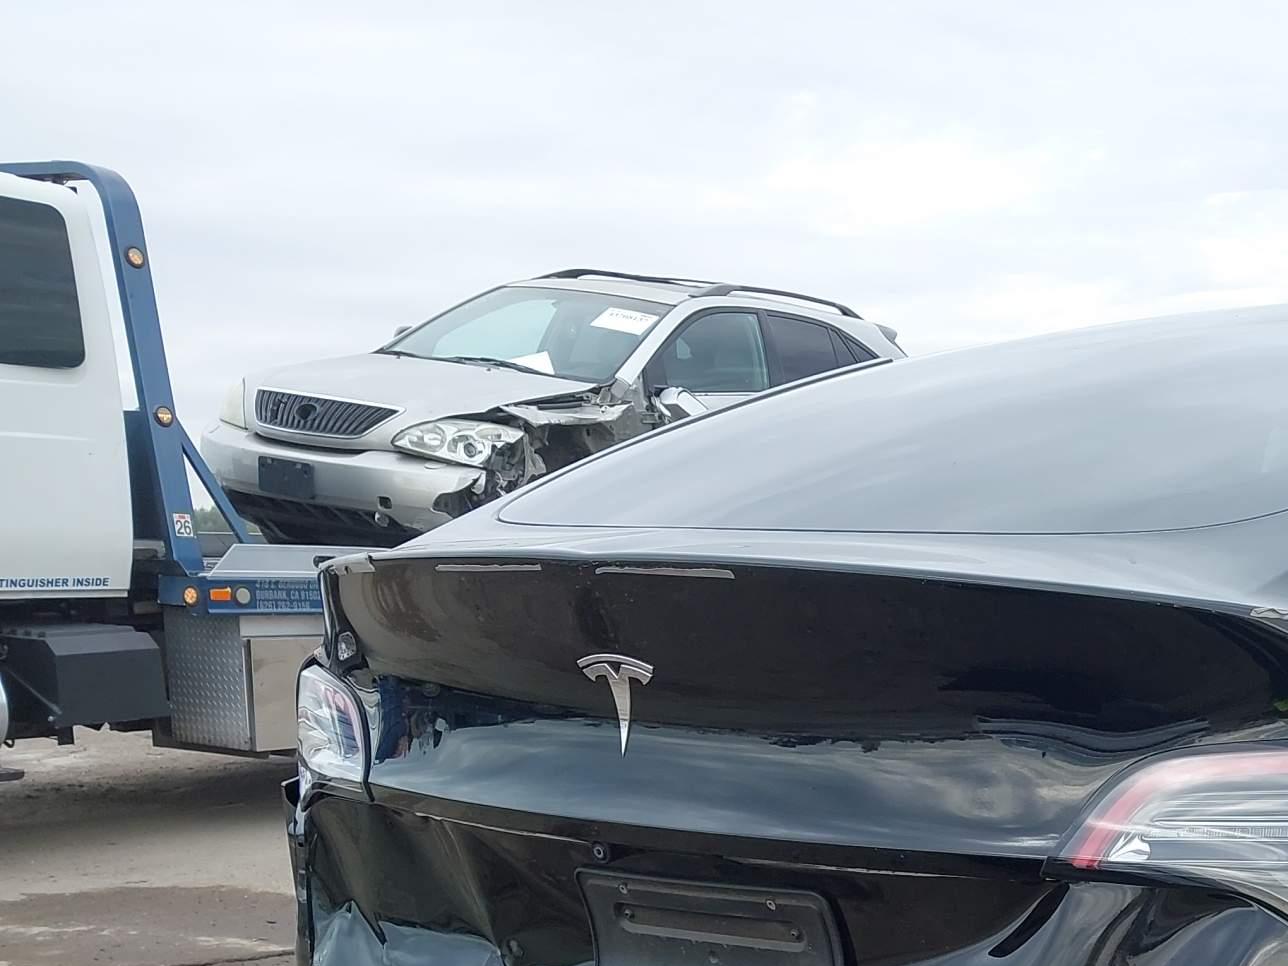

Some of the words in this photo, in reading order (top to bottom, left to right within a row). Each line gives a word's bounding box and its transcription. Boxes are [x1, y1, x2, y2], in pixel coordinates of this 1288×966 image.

[175, 519, 192, 536] 26
[72, 577, 110, 587] INSIDE
[290, 590, 301, 601] CA
